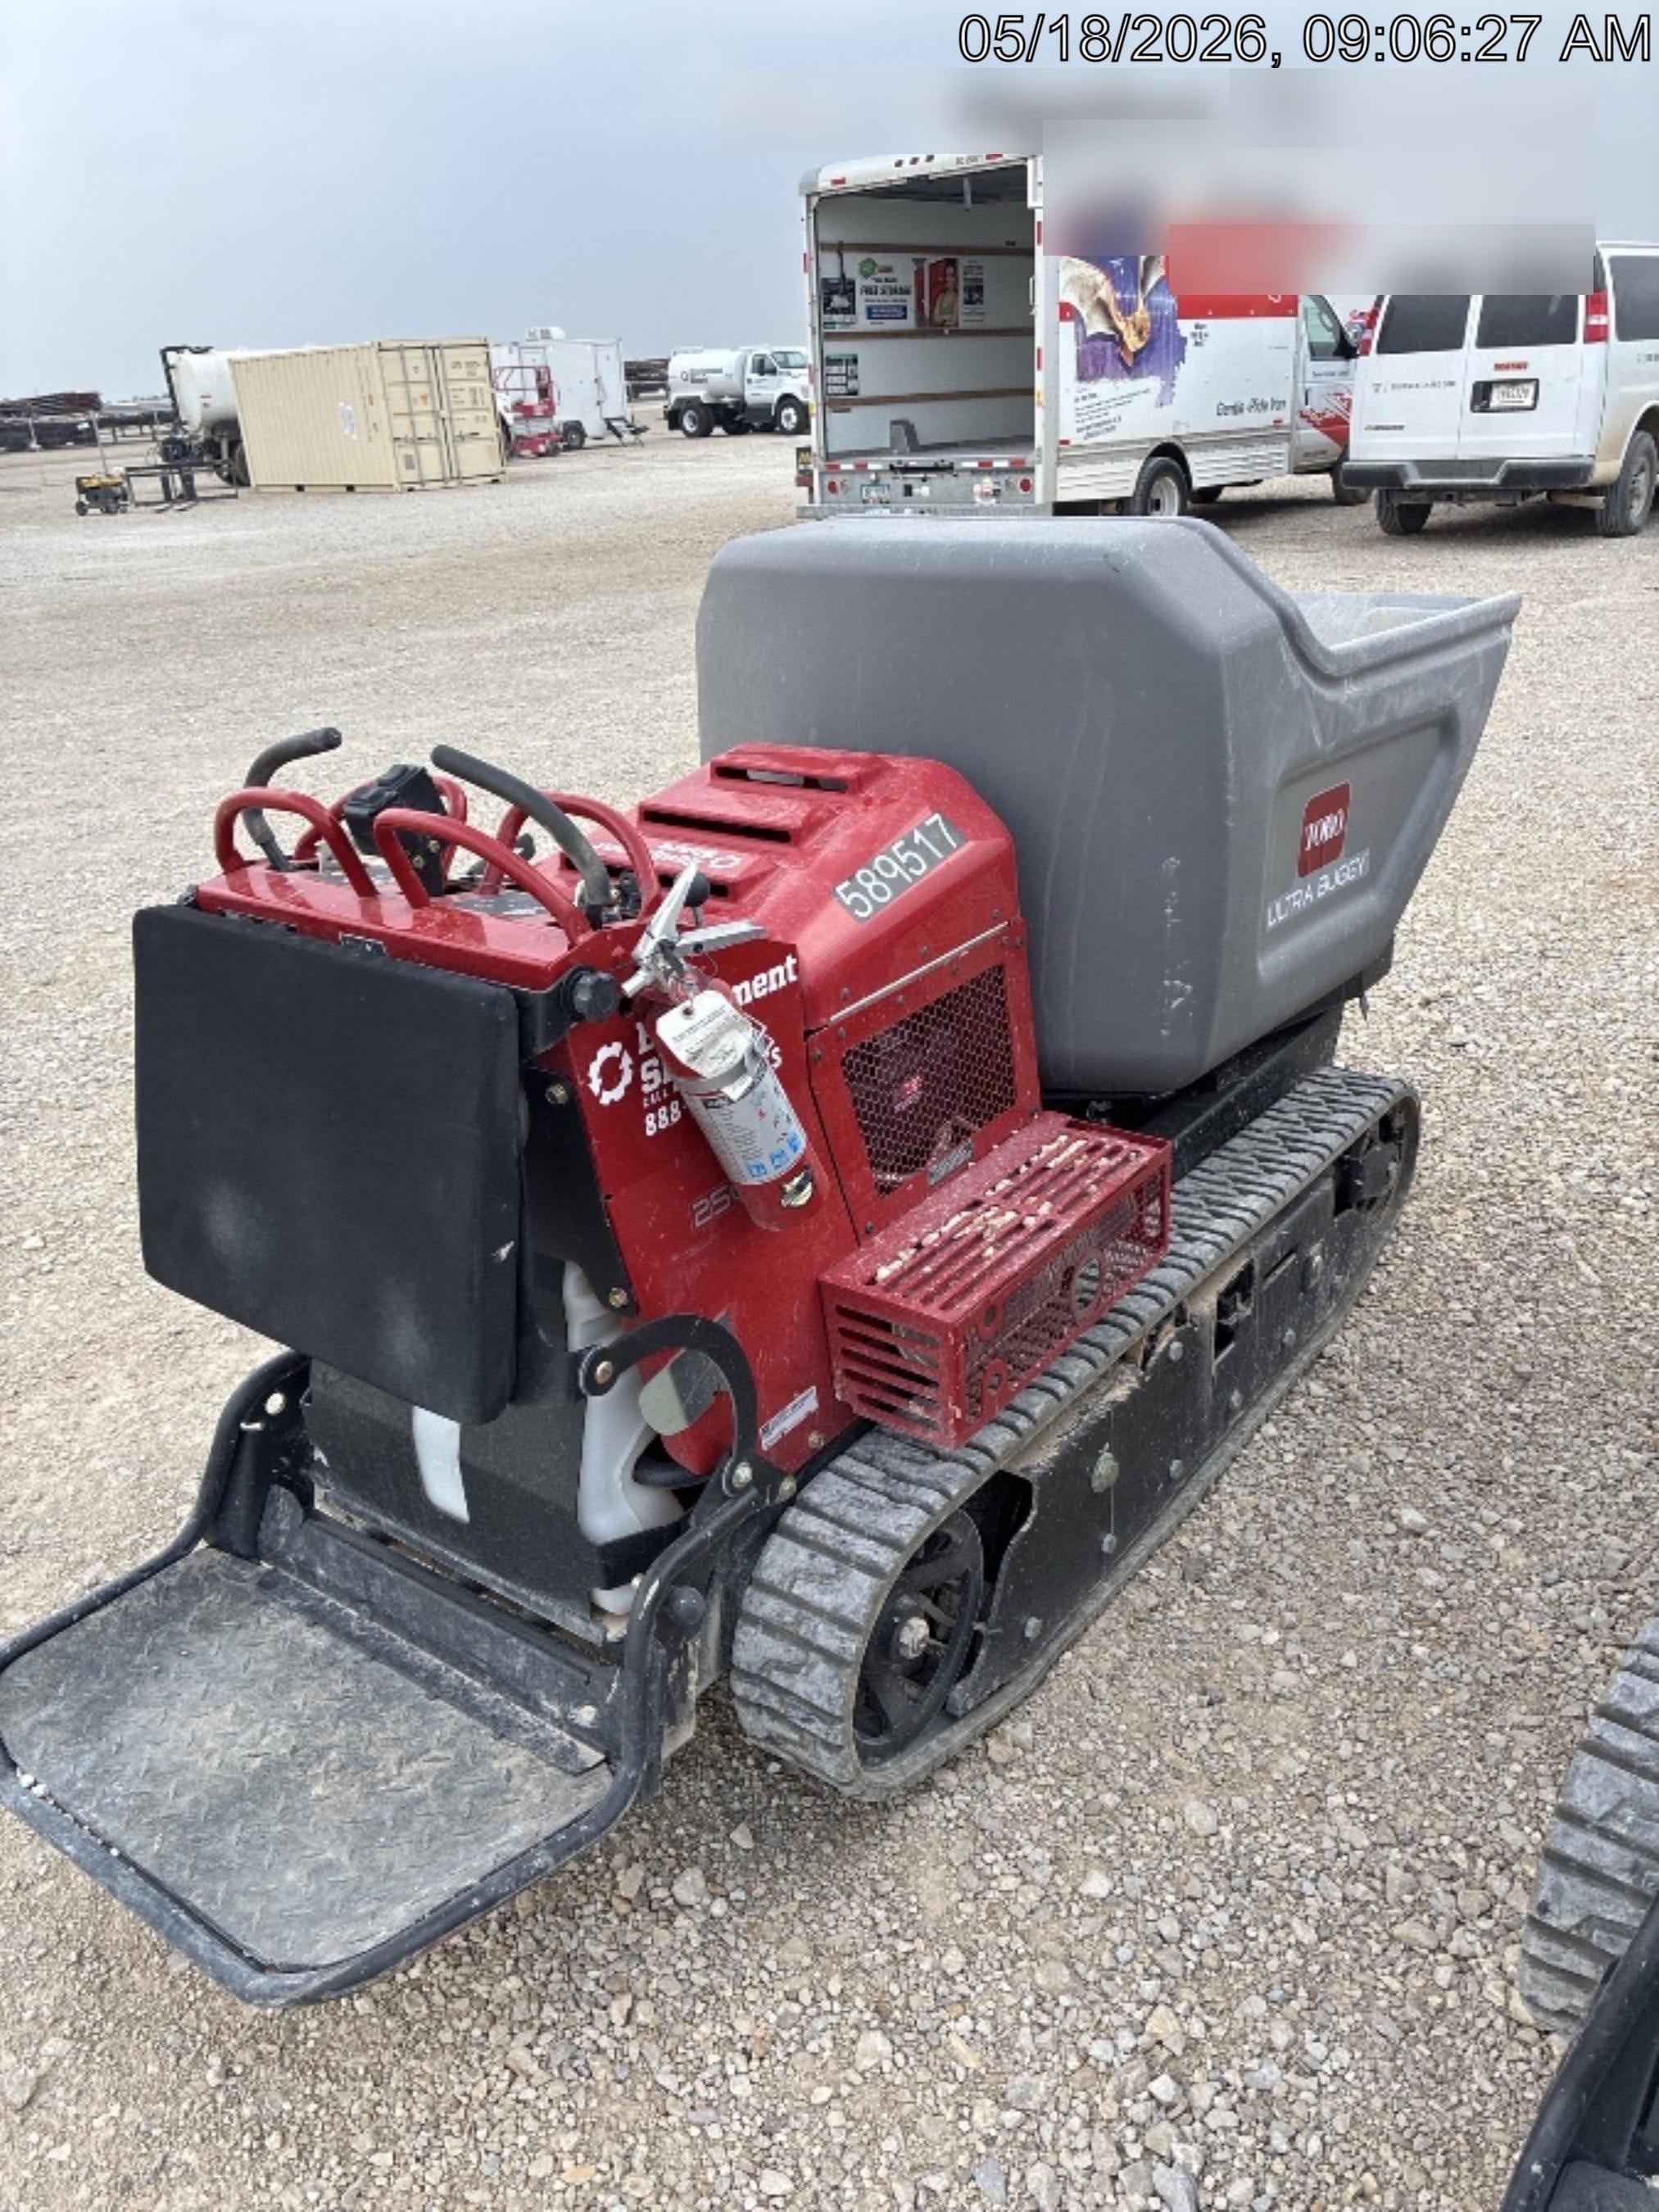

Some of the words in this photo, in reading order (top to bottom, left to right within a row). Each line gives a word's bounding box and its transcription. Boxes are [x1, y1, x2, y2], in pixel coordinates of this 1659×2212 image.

[835, 813, 958, 918] 589517
[1304, 808, 1346, 851] TORO
[1267, 883, 1314, 927] ULTRA
[1316, 850, 1368, 899] BUGGY
